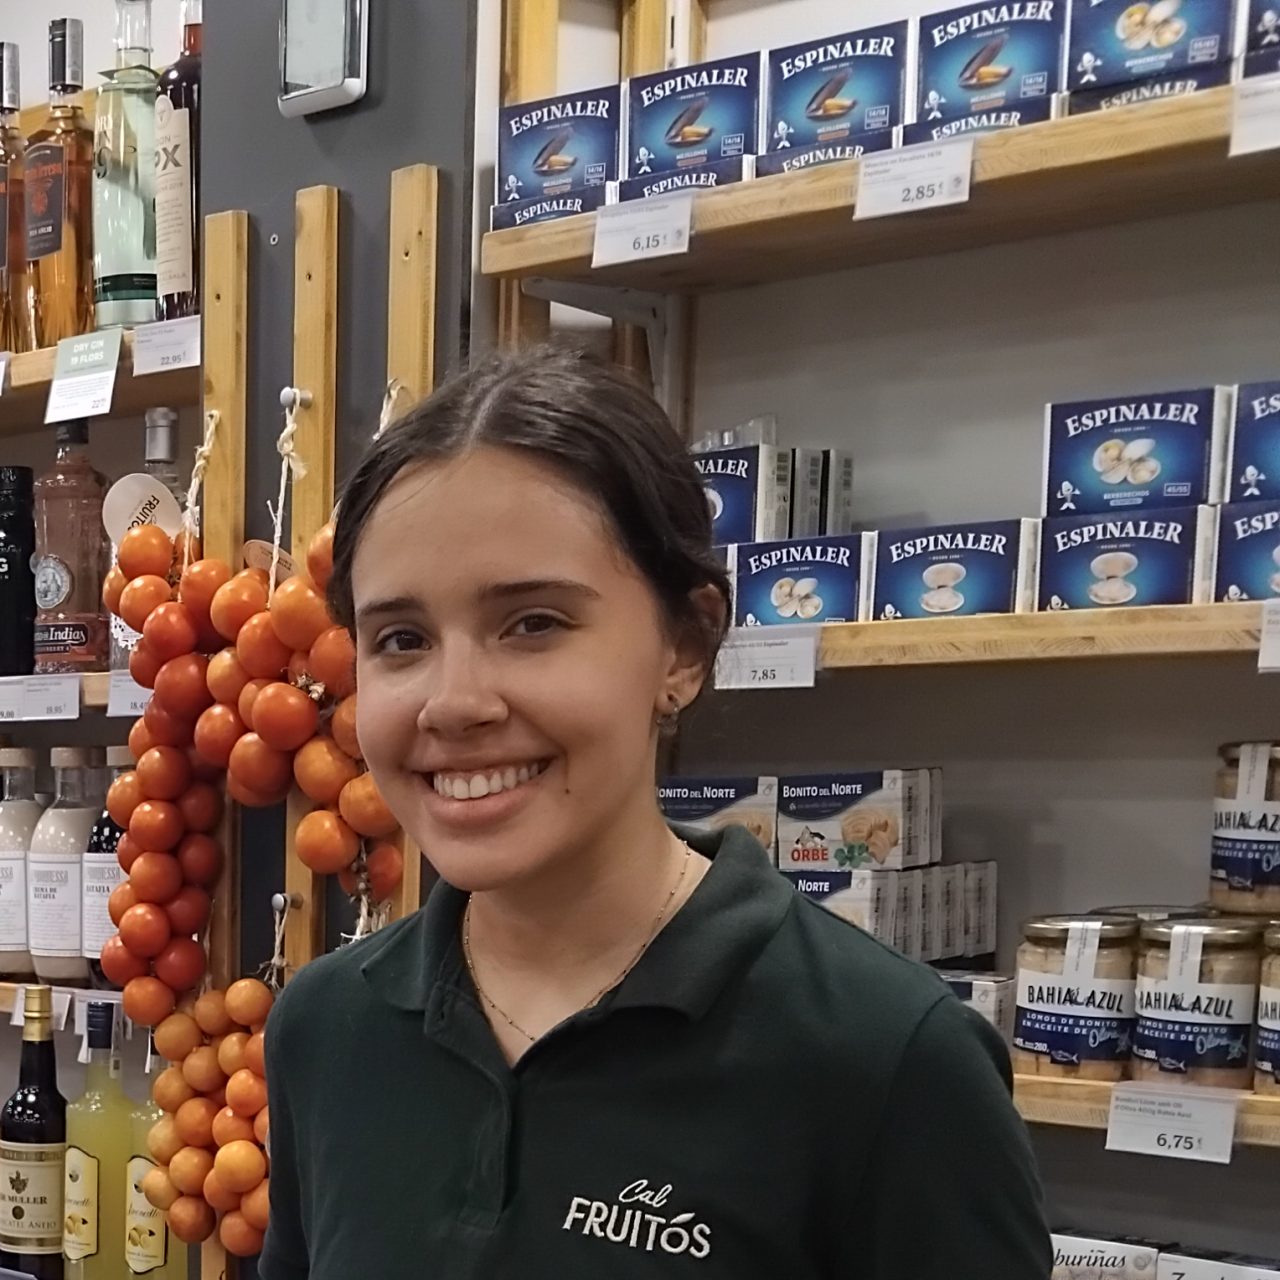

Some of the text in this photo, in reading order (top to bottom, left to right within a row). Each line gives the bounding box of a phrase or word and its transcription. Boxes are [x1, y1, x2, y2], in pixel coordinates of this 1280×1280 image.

[932, 1, 1054, 48] ESPINALER
[780, 36, 895, 80] ESPINALER
[640, 66, 748, 108] ESPINALER
[509, 99, 610, 137] ESPINALER
[932, 111, 1022, 142] ESPINALER
[782, 145, 864, 173] ESPINALER
[642, 172, 718, 198] ESPINALER
[901, 183, 936, 204] 2,85
[514, 198, 583, 226] ESPINALER
[632, 235, 660, 252] 6,15
[1065, 402, 1200, 438] ESPINALER
[888, 532, 1008, 564] ESPINALER
[1053, 520, 1184, 552] ESPINALER
[748, 546, 851, 575] ESPINALER
[751, 669, 777, 683] 7,85
[689, 789, 702, 798] DEL
[703, 786, 736, 799] NORTE
[782, 783, 863, 798] BONITO DEL NORTE
[790, 847, 829, 862] ORBE
[797, 879, 830, 893] NORTE
[1027, 985, 1124, 1013] BAHIA AZUL
[1190, 994, 1234, 1019] AZUL
[1022, 1019, 1031, 1028] EN
[1034, 1022, 1069, 1033] ACEITE
[1074, 1027, 1088, 1036] DE
[1026, 1012, 1118, 1028] LOMOS DE BONITO
[1167, 1023, 1180, 1032] DE
[1185, 1025, 1228, 1035] BONITO
[1144, 1029, 1175, 1041] ACEITE
[1180, 1033, 1194, 1042] DE
[1156, 1133, 1194, 1150] 6,75
[618, 1179, 673, 1208] Cal
[561, 1196, 712, 1259] FRUITÓS
